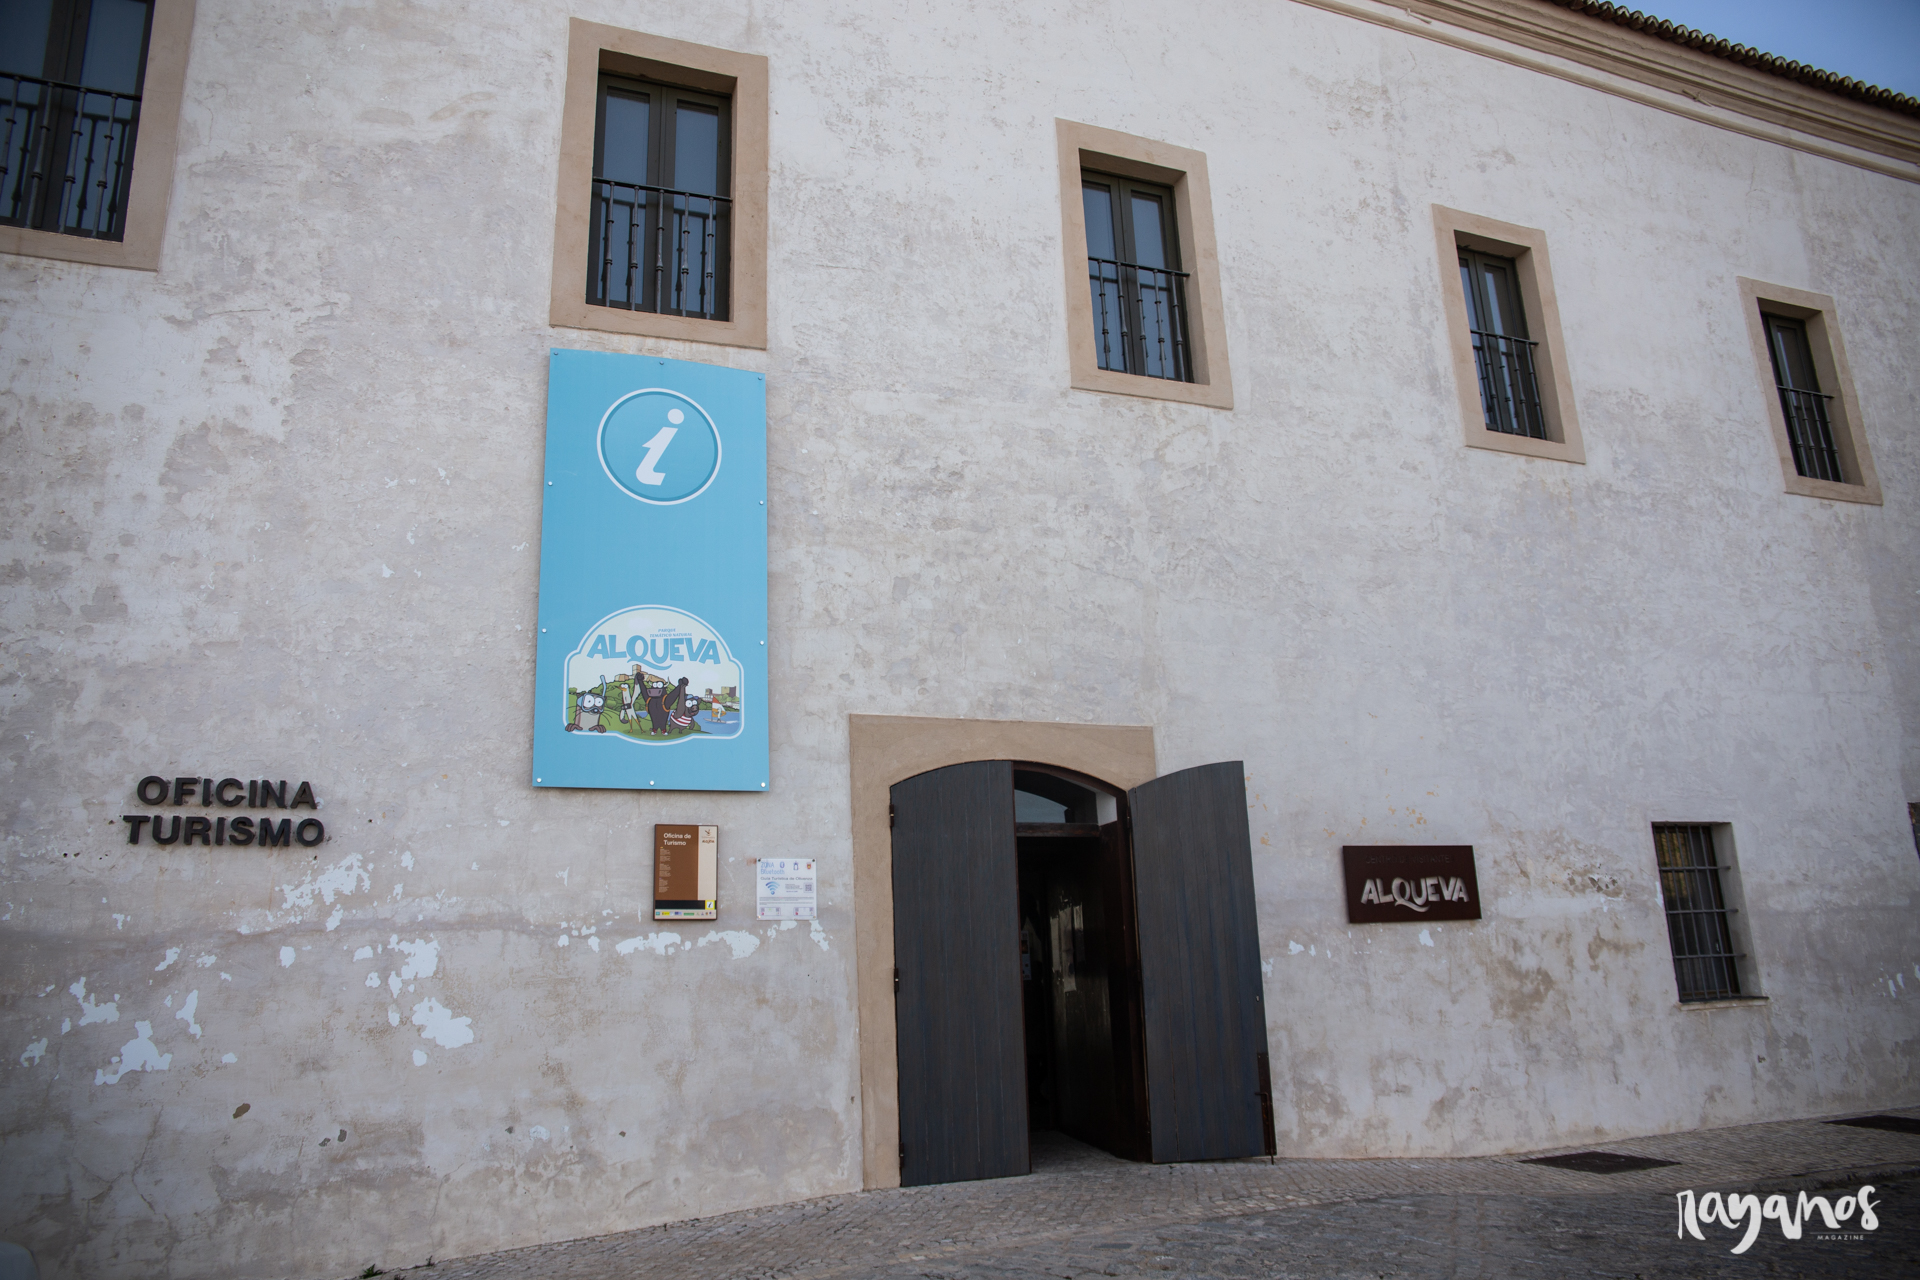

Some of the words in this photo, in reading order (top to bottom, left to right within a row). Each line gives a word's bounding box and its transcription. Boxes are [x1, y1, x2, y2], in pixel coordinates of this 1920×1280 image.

[586, 634, 721, 671] ALQUEVA
[137, 776, 317, 809] OFICINA
[123, 815, 325, 847] TURISMO
[1360, 876, 1470, 913] ALQUEVA
